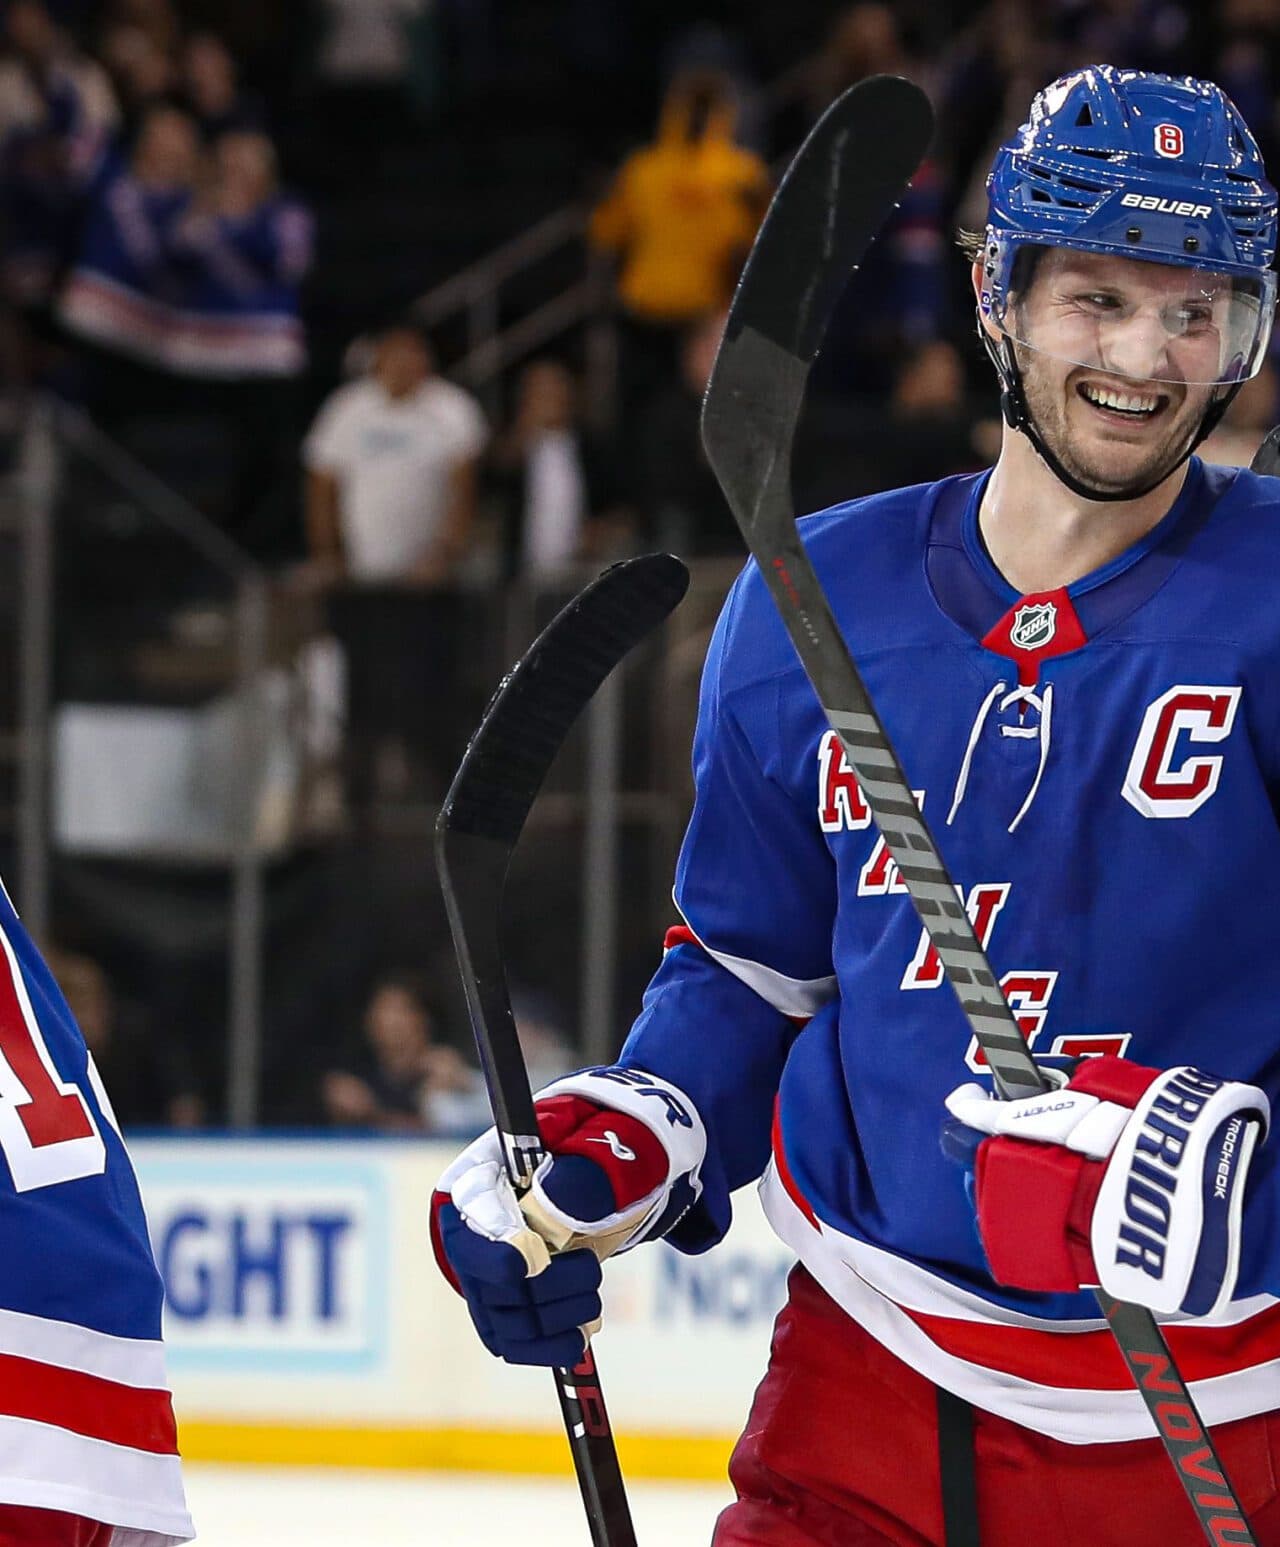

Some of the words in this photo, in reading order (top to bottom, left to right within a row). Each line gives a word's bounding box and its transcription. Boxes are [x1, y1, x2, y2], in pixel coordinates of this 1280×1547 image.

[1153, 123, 1184, 158] 8
[1120, 193, 1213, 219] BAUER
[1020, 615, 1049, 640] NHL
[1120, 684, 1242, 819] C
[1012, 1100, 1075, 1120] COVERT
[162, 1211, 354, 1323] GHT
